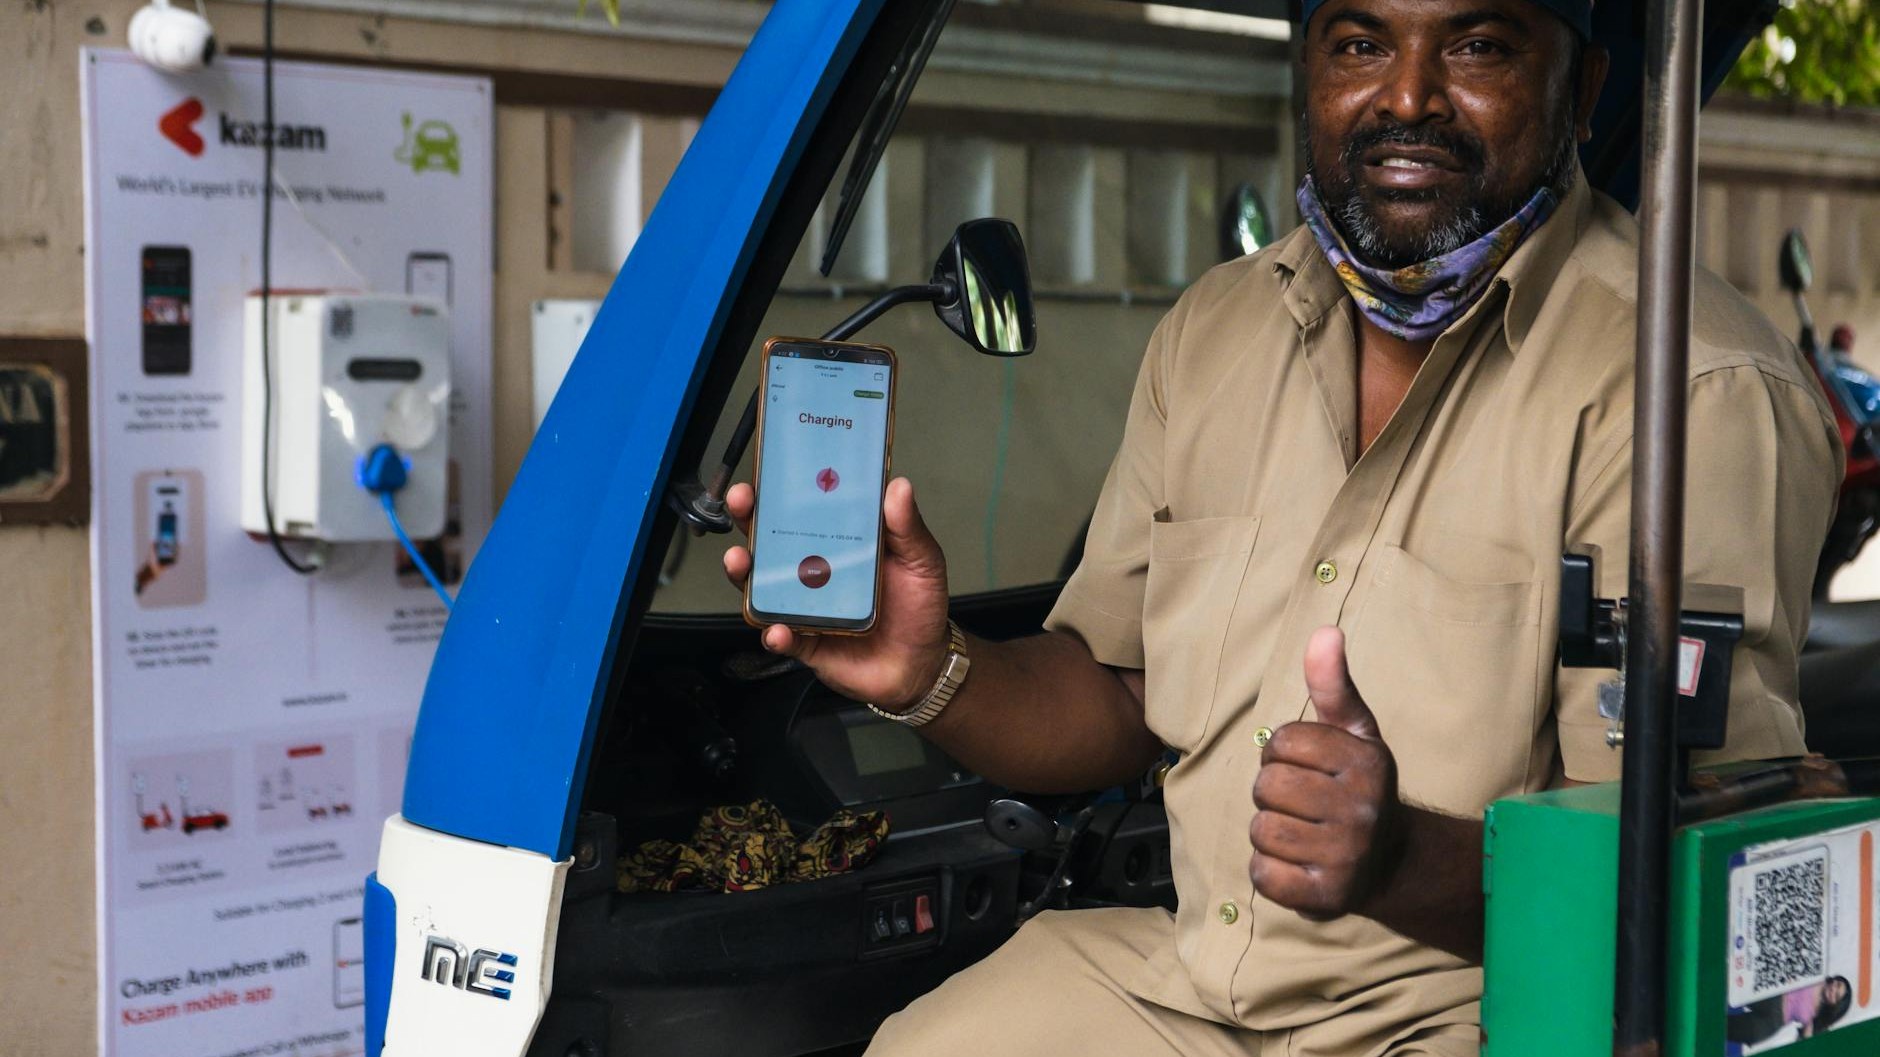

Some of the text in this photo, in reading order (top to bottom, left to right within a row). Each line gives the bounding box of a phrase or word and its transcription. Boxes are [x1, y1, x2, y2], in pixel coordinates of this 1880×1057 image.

[219, 112, 326, 151] kazam
[799, 412, 853, 429] Charging
[121, 950, 309, 999] Charge Anywhere with
[122, 1003, 178, 1026] Kazam
[184, 989, 239, 1013] mobile
